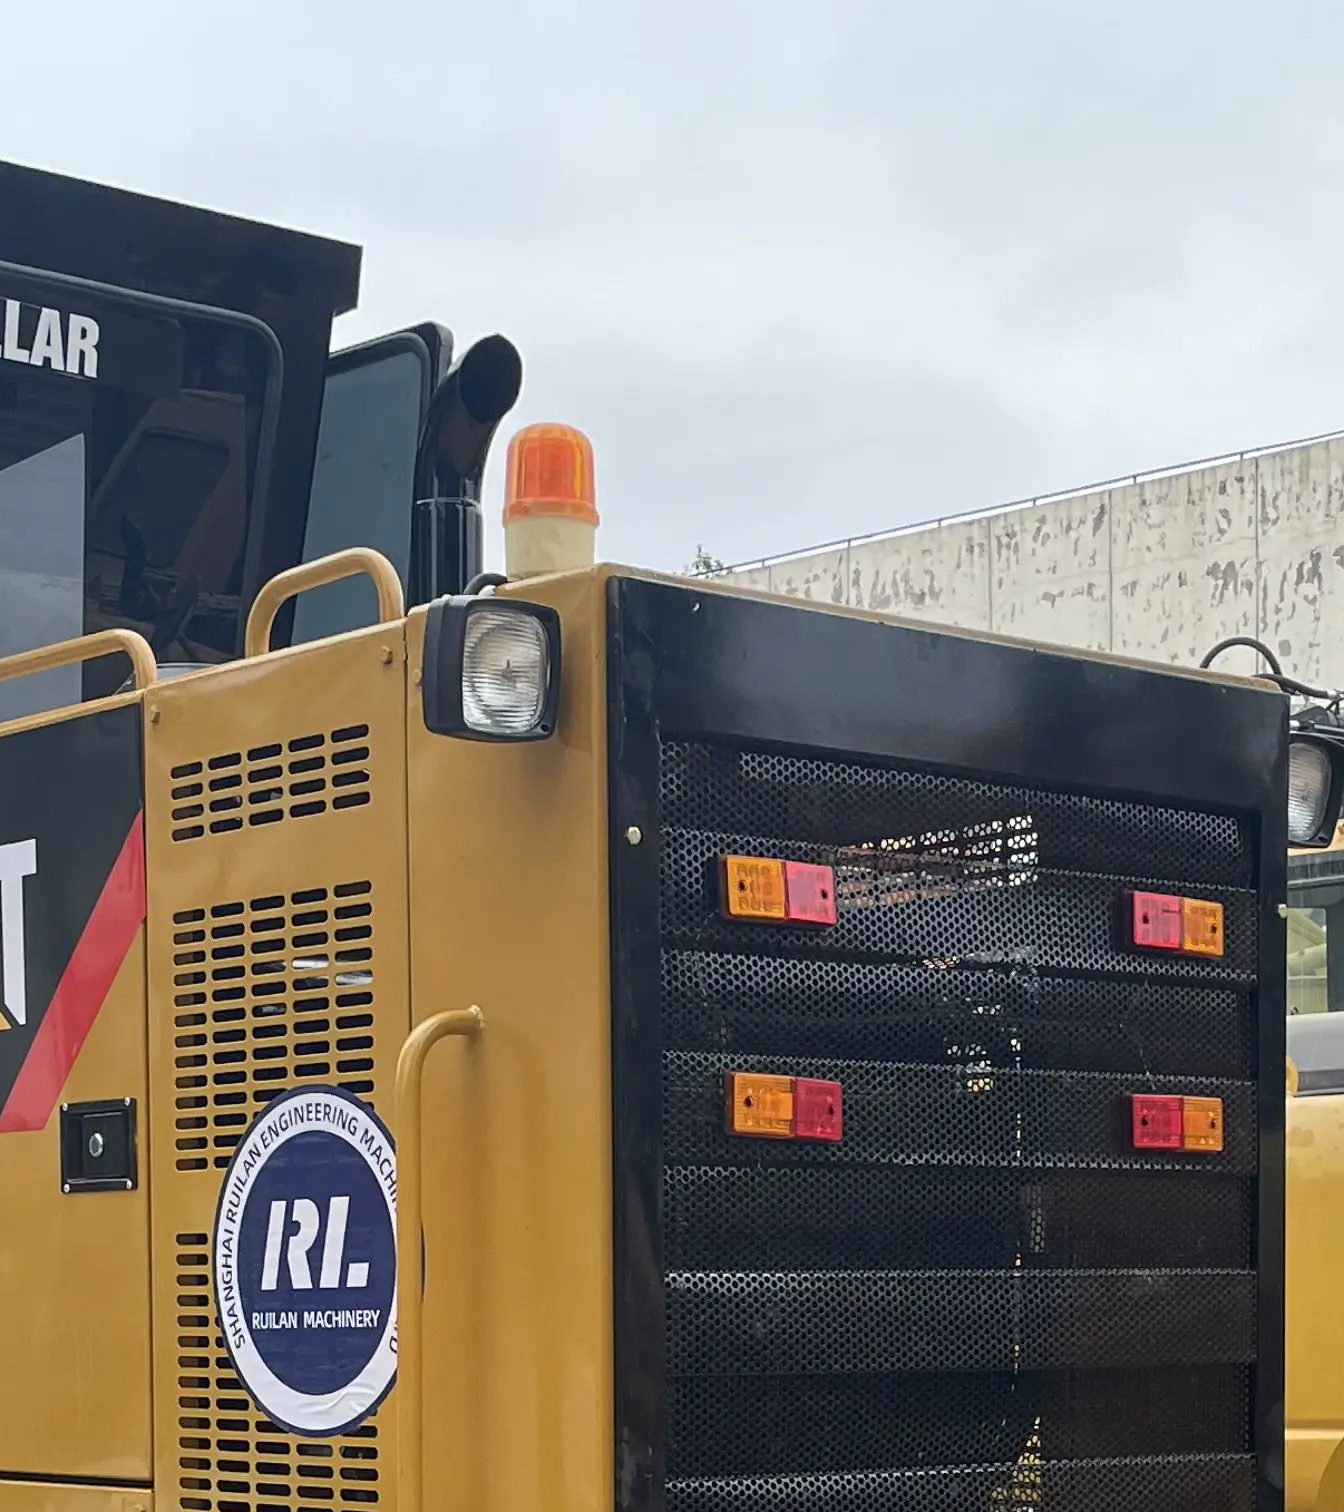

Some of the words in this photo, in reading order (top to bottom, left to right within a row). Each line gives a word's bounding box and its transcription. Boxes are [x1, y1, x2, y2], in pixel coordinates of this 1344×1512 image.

[261, 1102, 359, 1149] ENGINEERING
[232, 1143, 262, 1224] RUILAN
[360, 1128, 397, 1203] MACHI
[220, 1229, 246, 1349] SHANGHAI
[252, 1311, 298, 1330] RUILAN
[303, 1309, 381, 1329] MACHINERY
